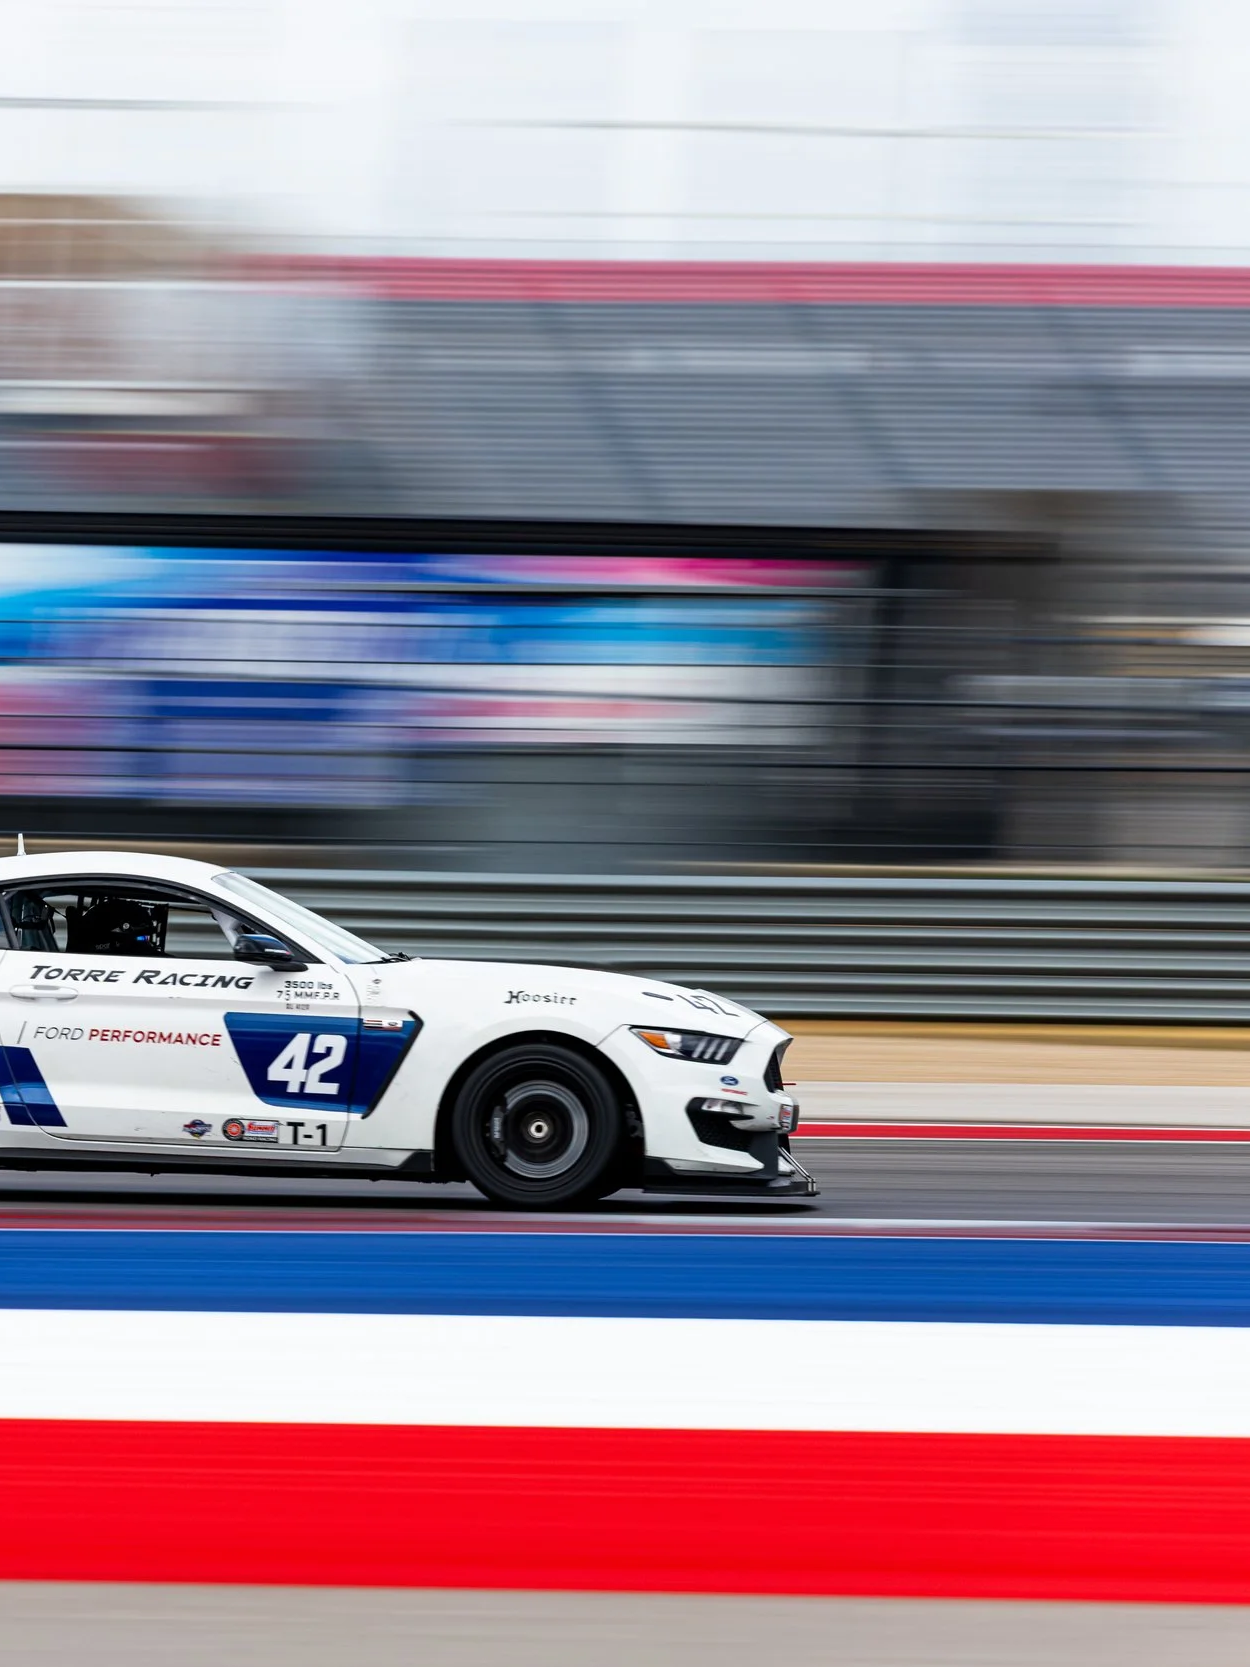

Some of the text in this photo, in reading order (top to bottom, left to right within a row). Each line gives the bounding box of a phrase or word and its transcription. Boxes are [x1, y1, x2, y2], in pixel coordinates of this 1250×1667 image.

[284, 980, 314, 989] 3500
[33, 1026, 222, 1047] FORD PERFORMANCE
[266, 1032, 348, 1095] 42
[286, 1121, 328, 1146] T-1
